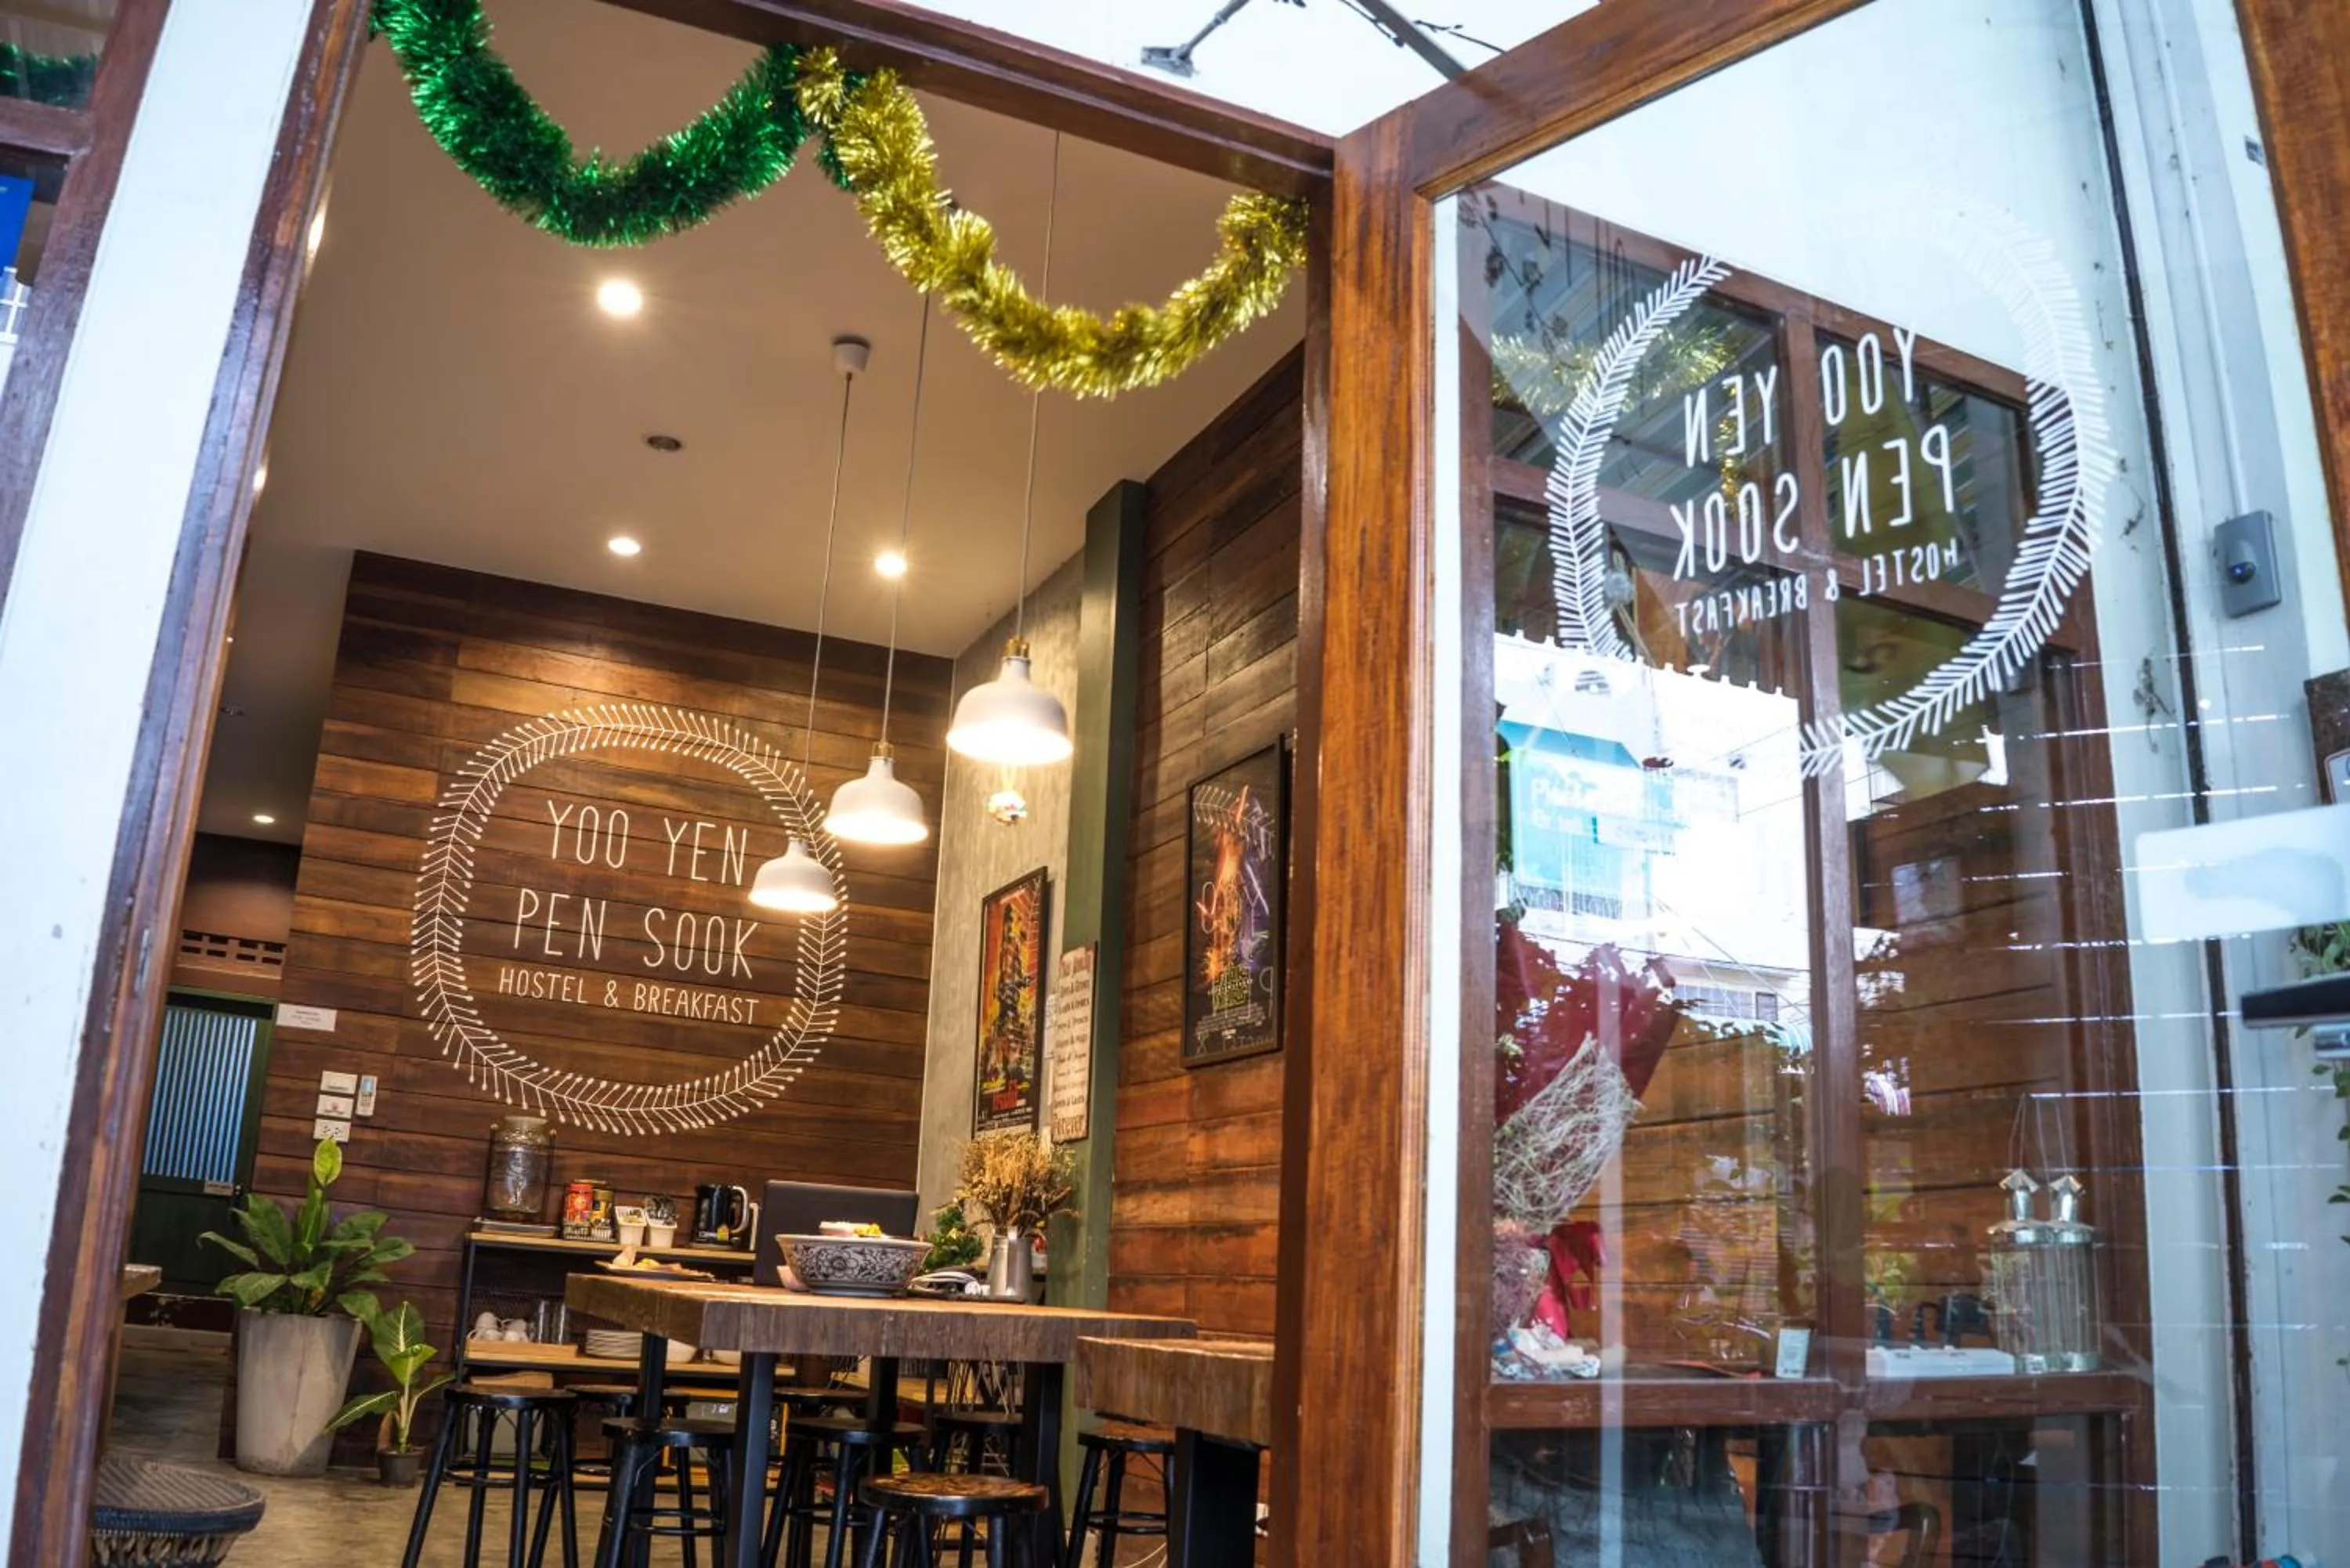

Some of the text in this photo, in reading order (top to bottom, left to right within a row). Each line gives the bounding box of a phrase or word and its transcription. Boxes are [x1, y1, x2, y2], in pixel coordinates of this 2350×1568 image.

[548, 799, 748, 887] YOO YEN
[513, 887, 760, 979] PEN SOOK
[499, 966, 761, 1025] HOSTEL & BREAKFAST
